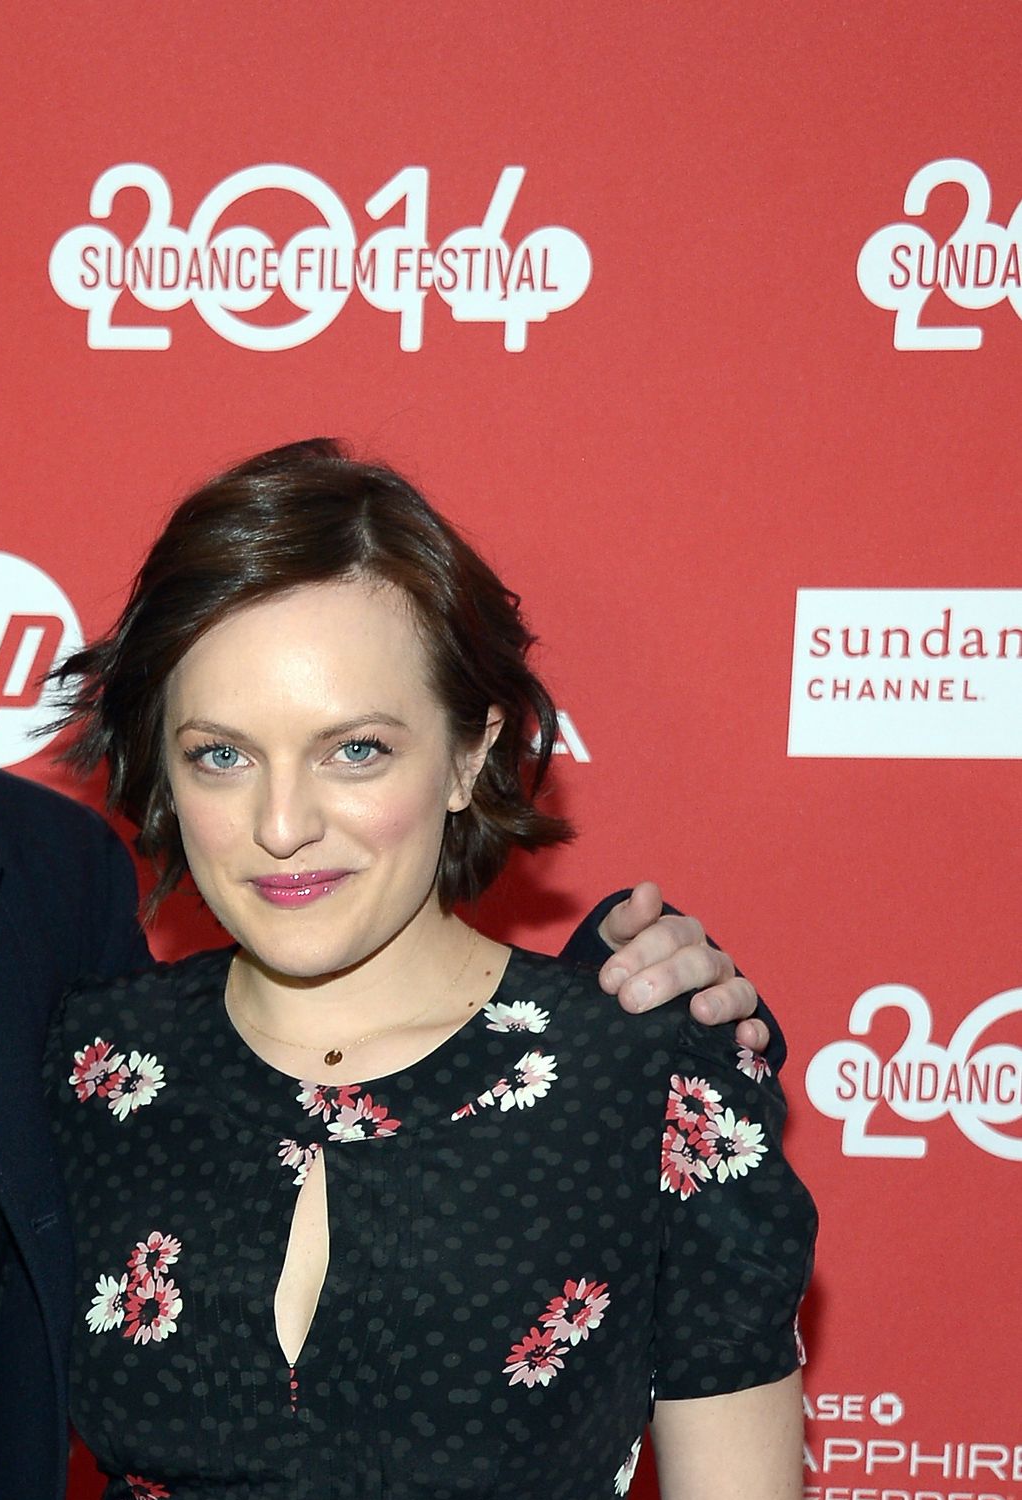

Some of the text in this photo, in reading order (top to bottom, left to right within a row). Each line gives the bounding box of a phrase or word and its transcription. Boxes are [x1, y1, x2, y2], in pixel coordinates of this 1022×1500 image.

[80, 246, 558, 293] SUNDANCE FILM FESTIVAL
[84, 162, 553, 352] 2014
[888, 243, 1022, 289] SUNDA
[809, 608, 1022, 658] sundan
[807, 678, 979, 701] CHANNEL
[836, 1060, 1022, 1105] SUNDANC
[803, 1437, 1022, 1481] PPHIR
